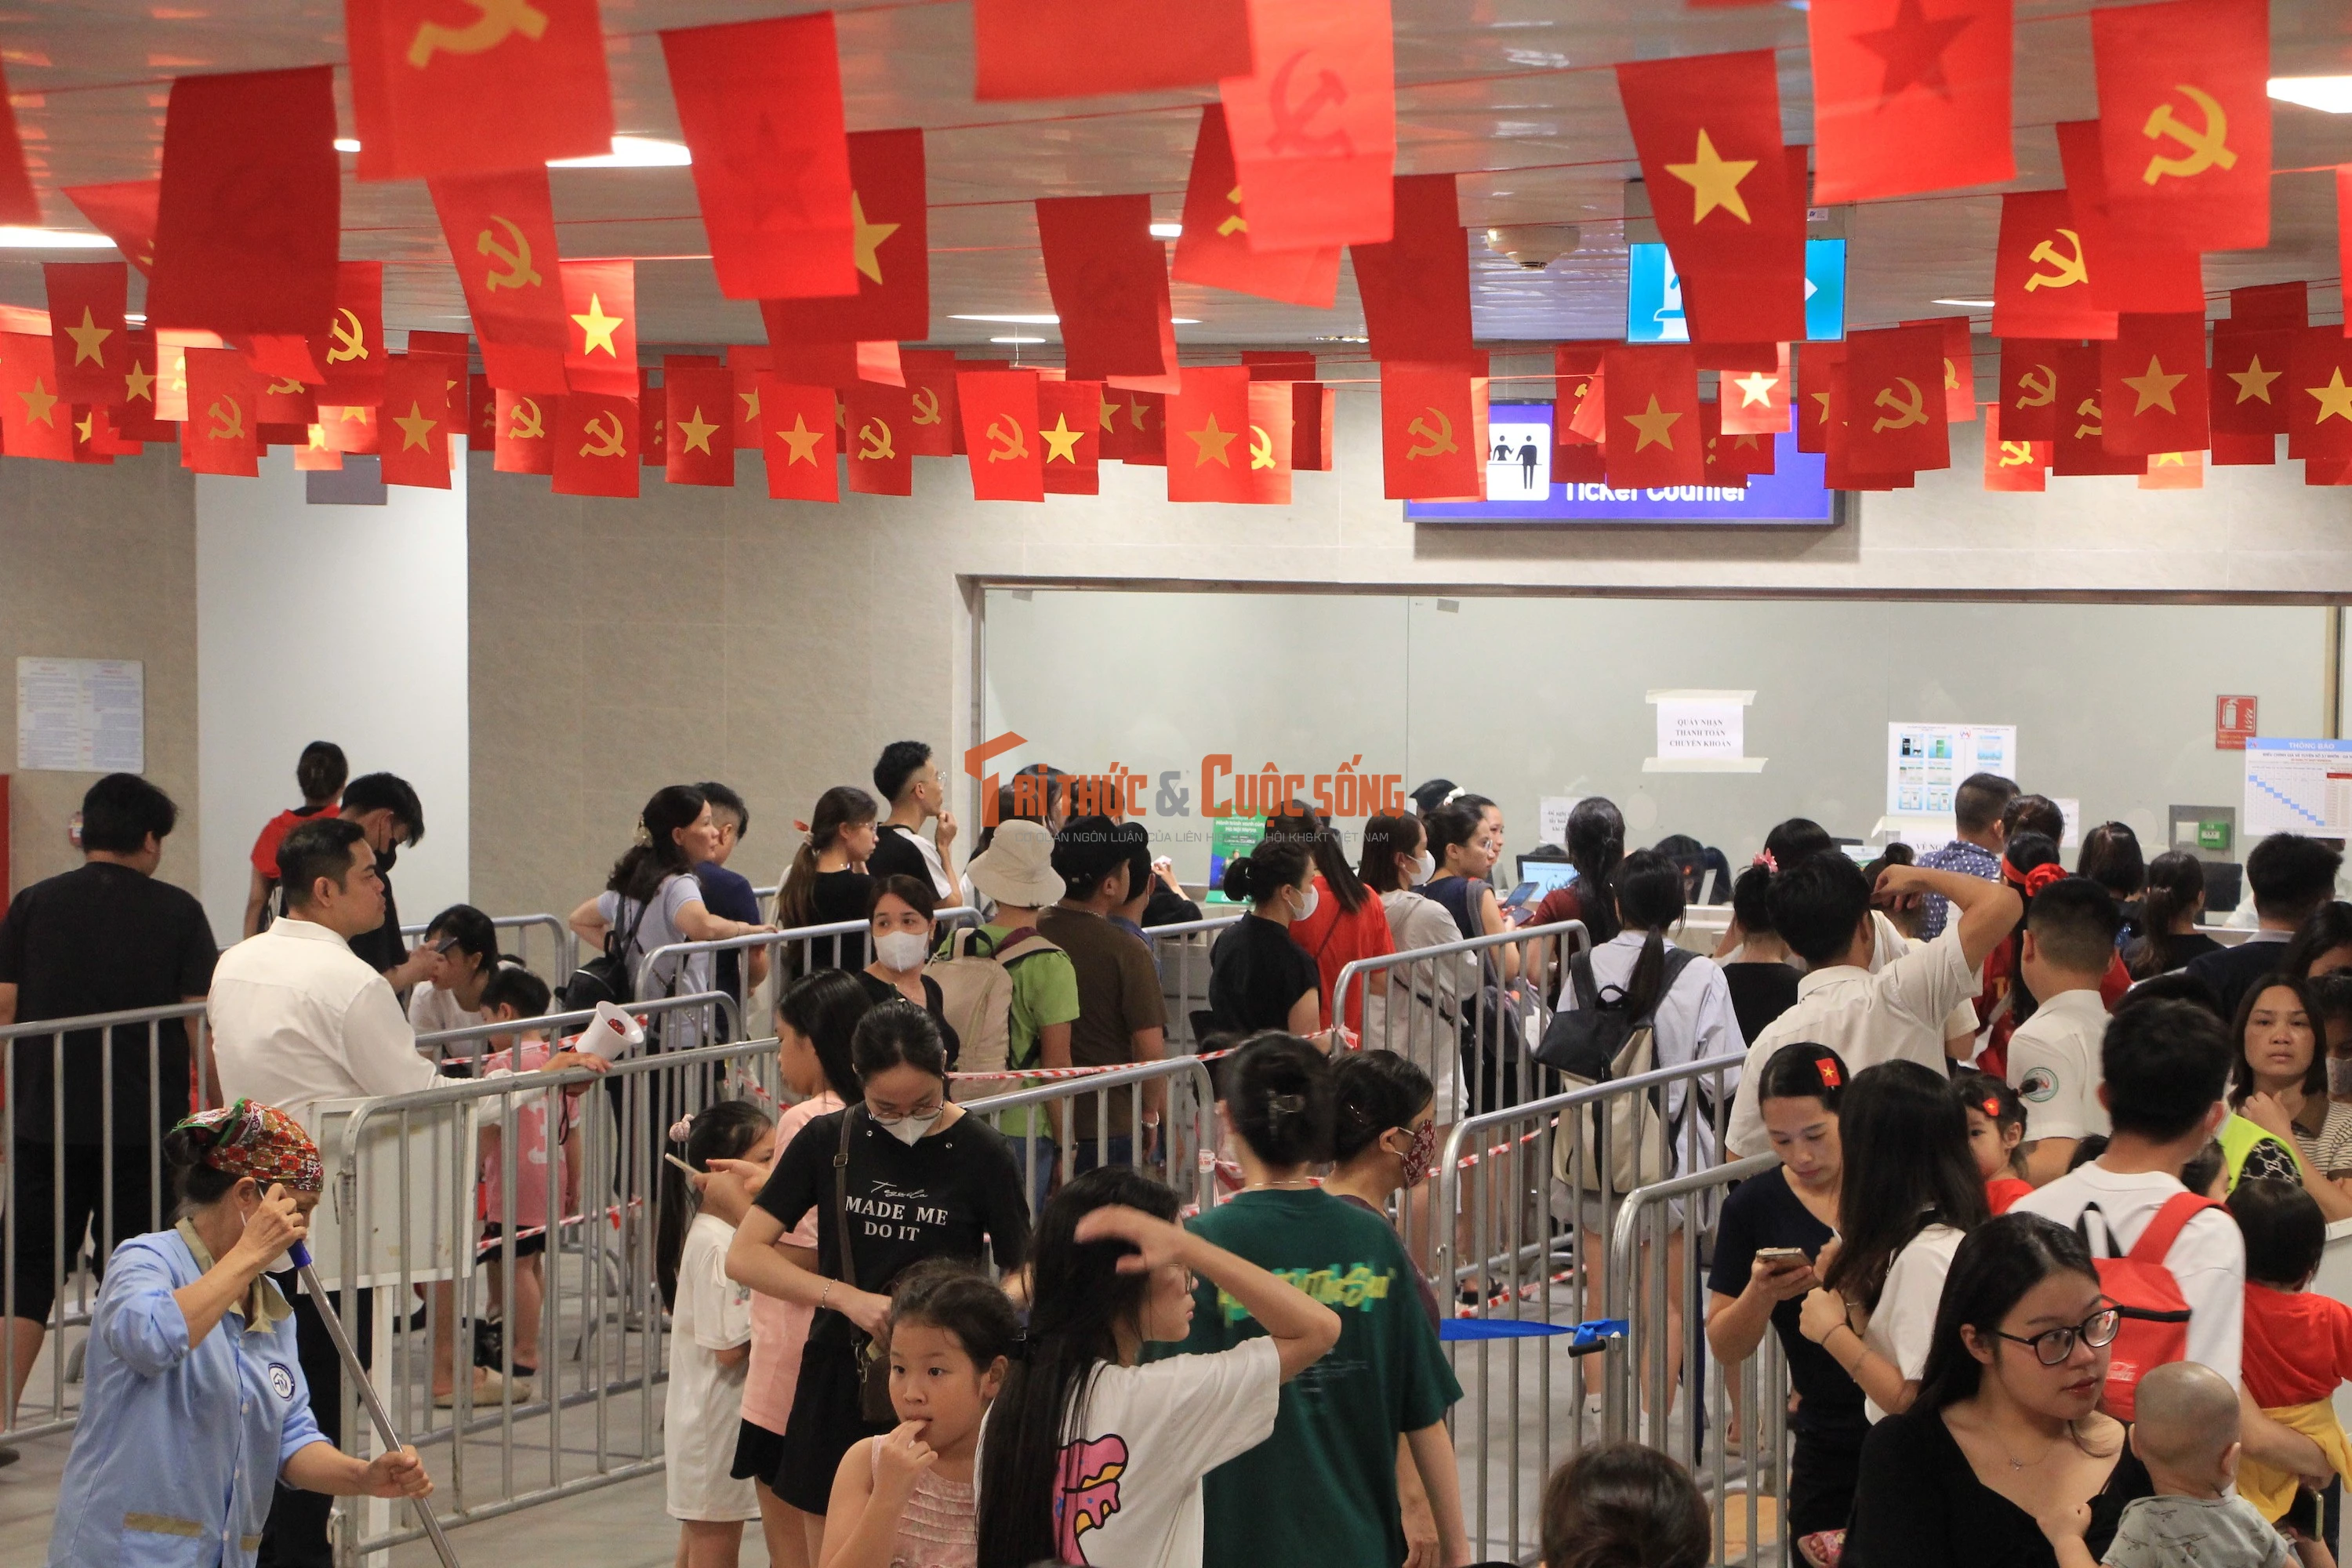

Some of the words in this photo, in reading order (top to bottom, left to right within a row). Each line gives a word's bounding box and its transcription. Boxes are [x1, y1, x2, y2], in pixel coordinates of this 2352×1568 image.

[845, 1196, 906, 1221] MADE
[916, 1207, 949, 1226] ME
[864, 1221, 892, 1238] DO
[898, 1225, 920, 1242] IT
